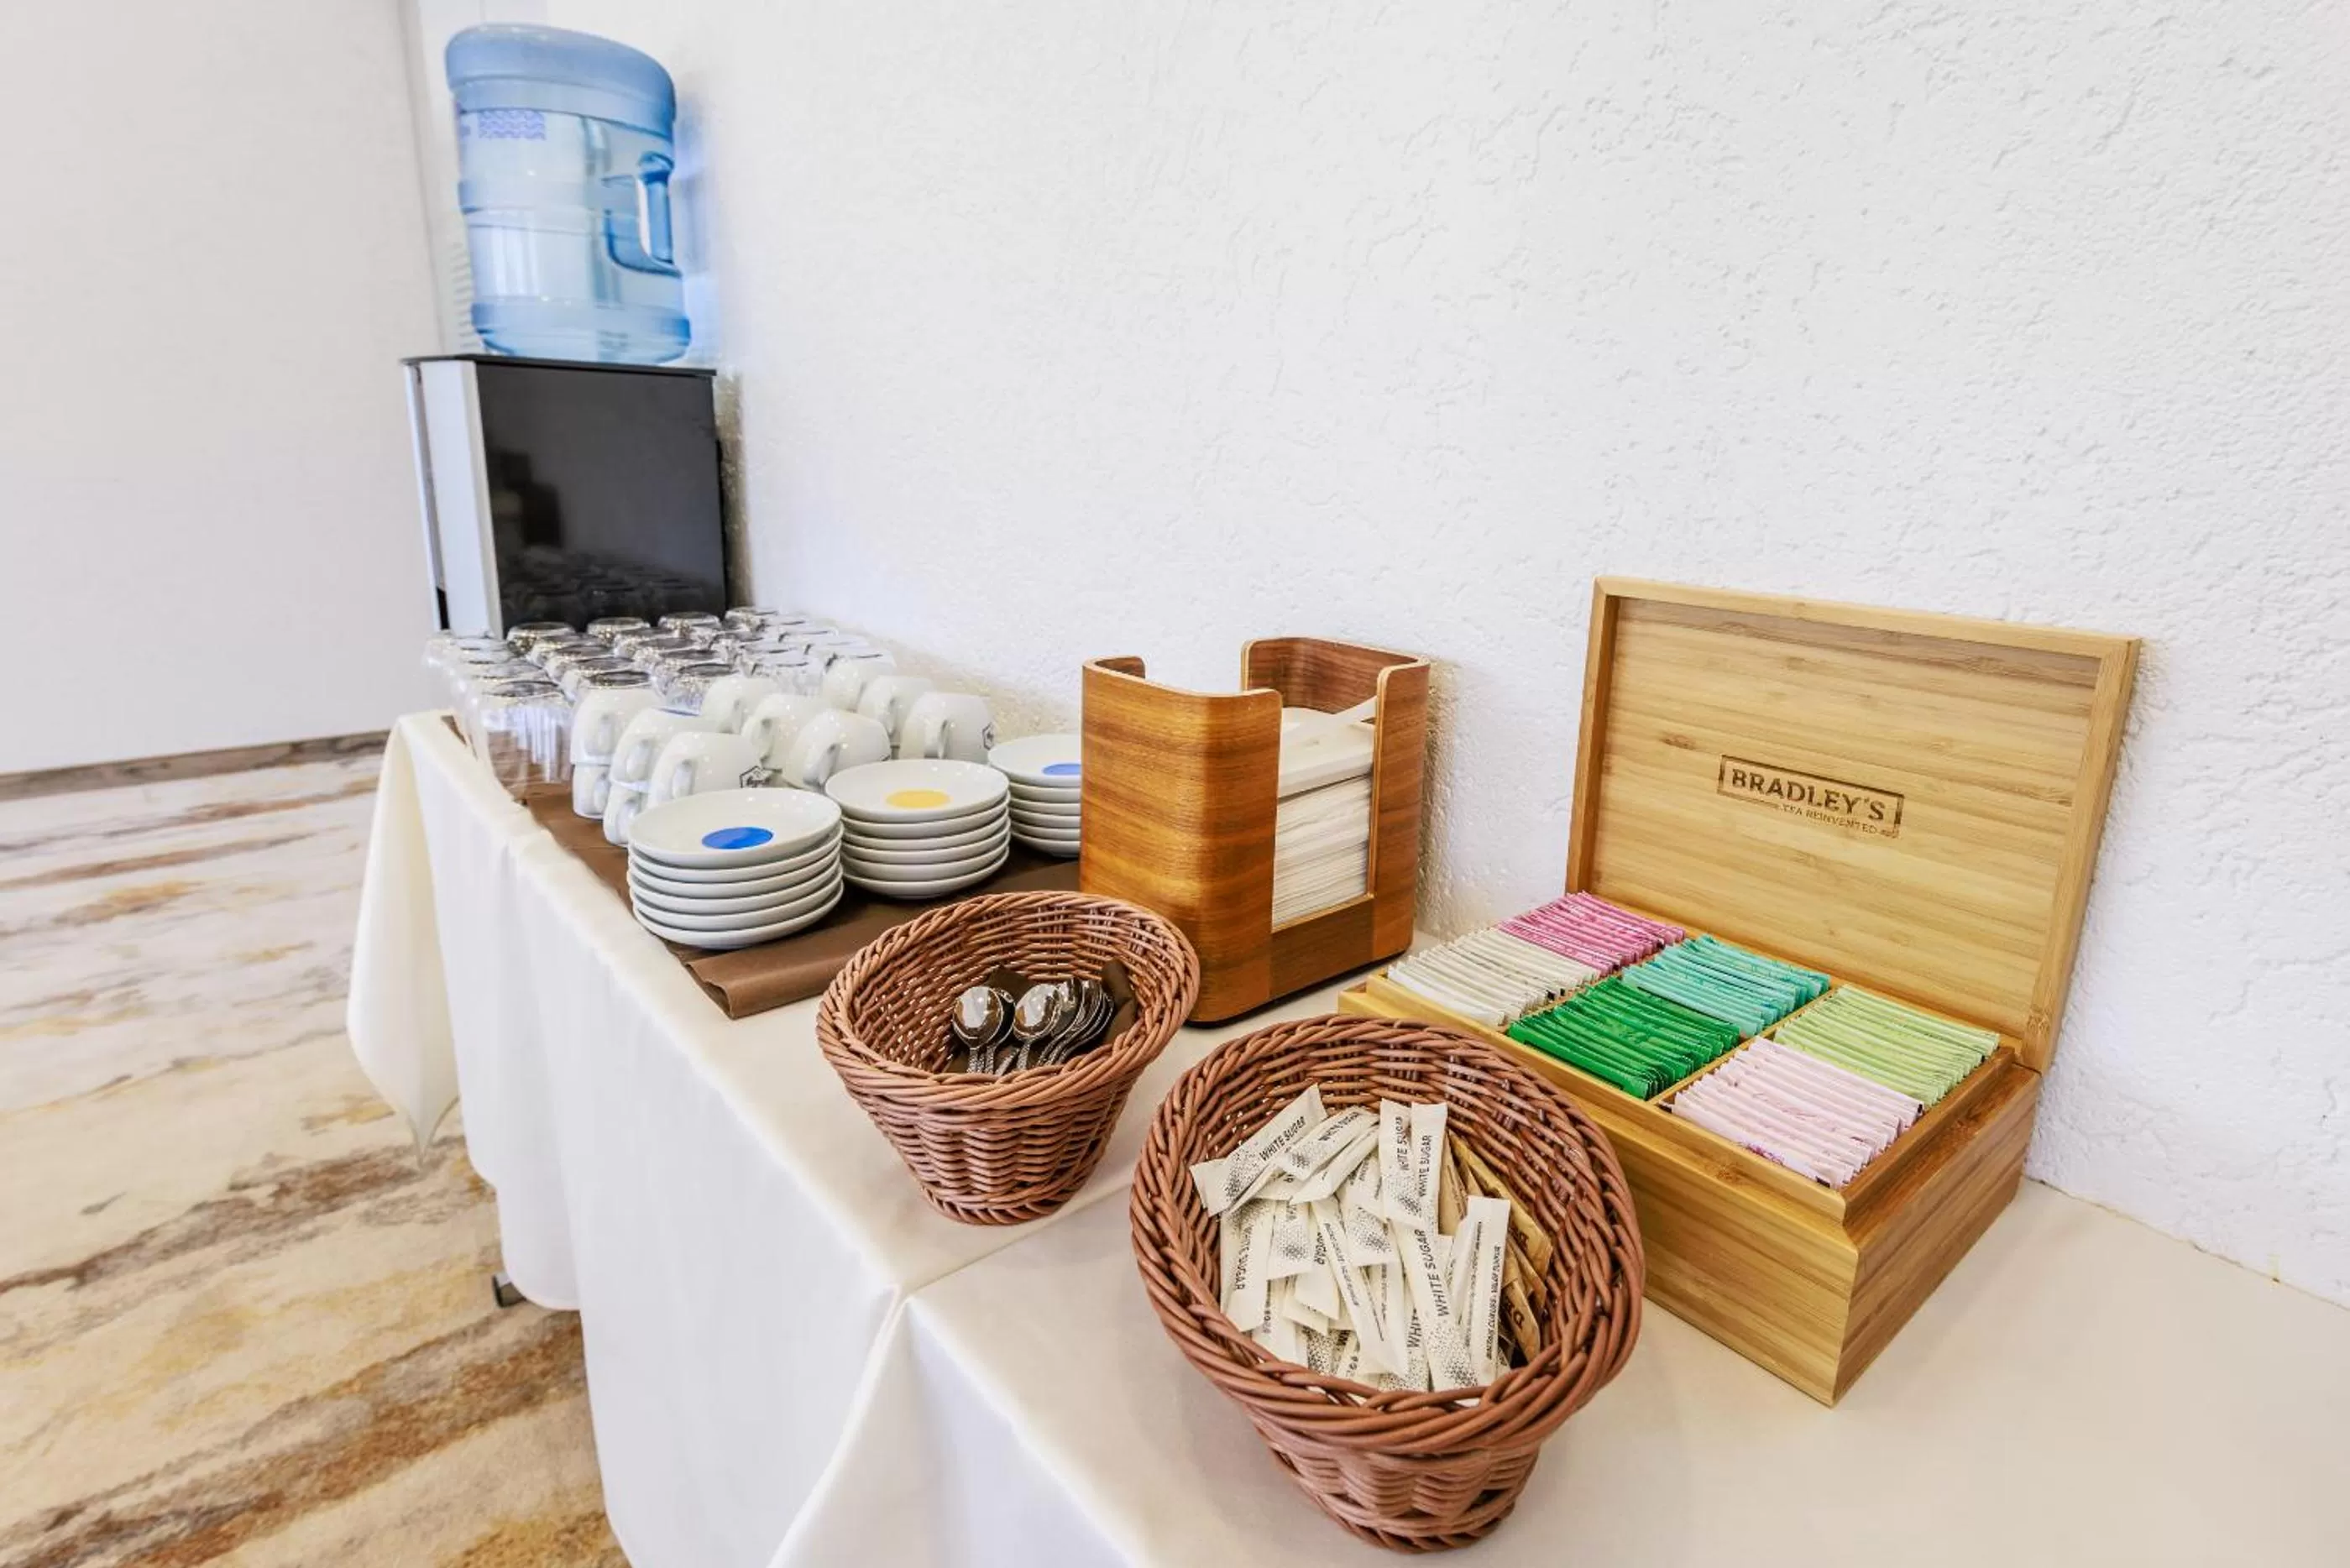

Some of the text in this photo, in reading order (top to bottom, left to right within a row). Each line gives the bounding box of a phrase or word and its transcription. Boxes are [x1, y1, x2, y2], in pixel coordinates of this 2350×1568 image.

[1731, 767, 1886, 821] BRADLEY'S
[1782, 802, 1877, 834] TEA REINVENTED
[1259, 1116, 1306, 1161] WHITE SUGAR
[1419, 1135, 1432, 1197] WHITE SUGAR
[1414, 1228, 1450, 1317] WHITE SUGAR
